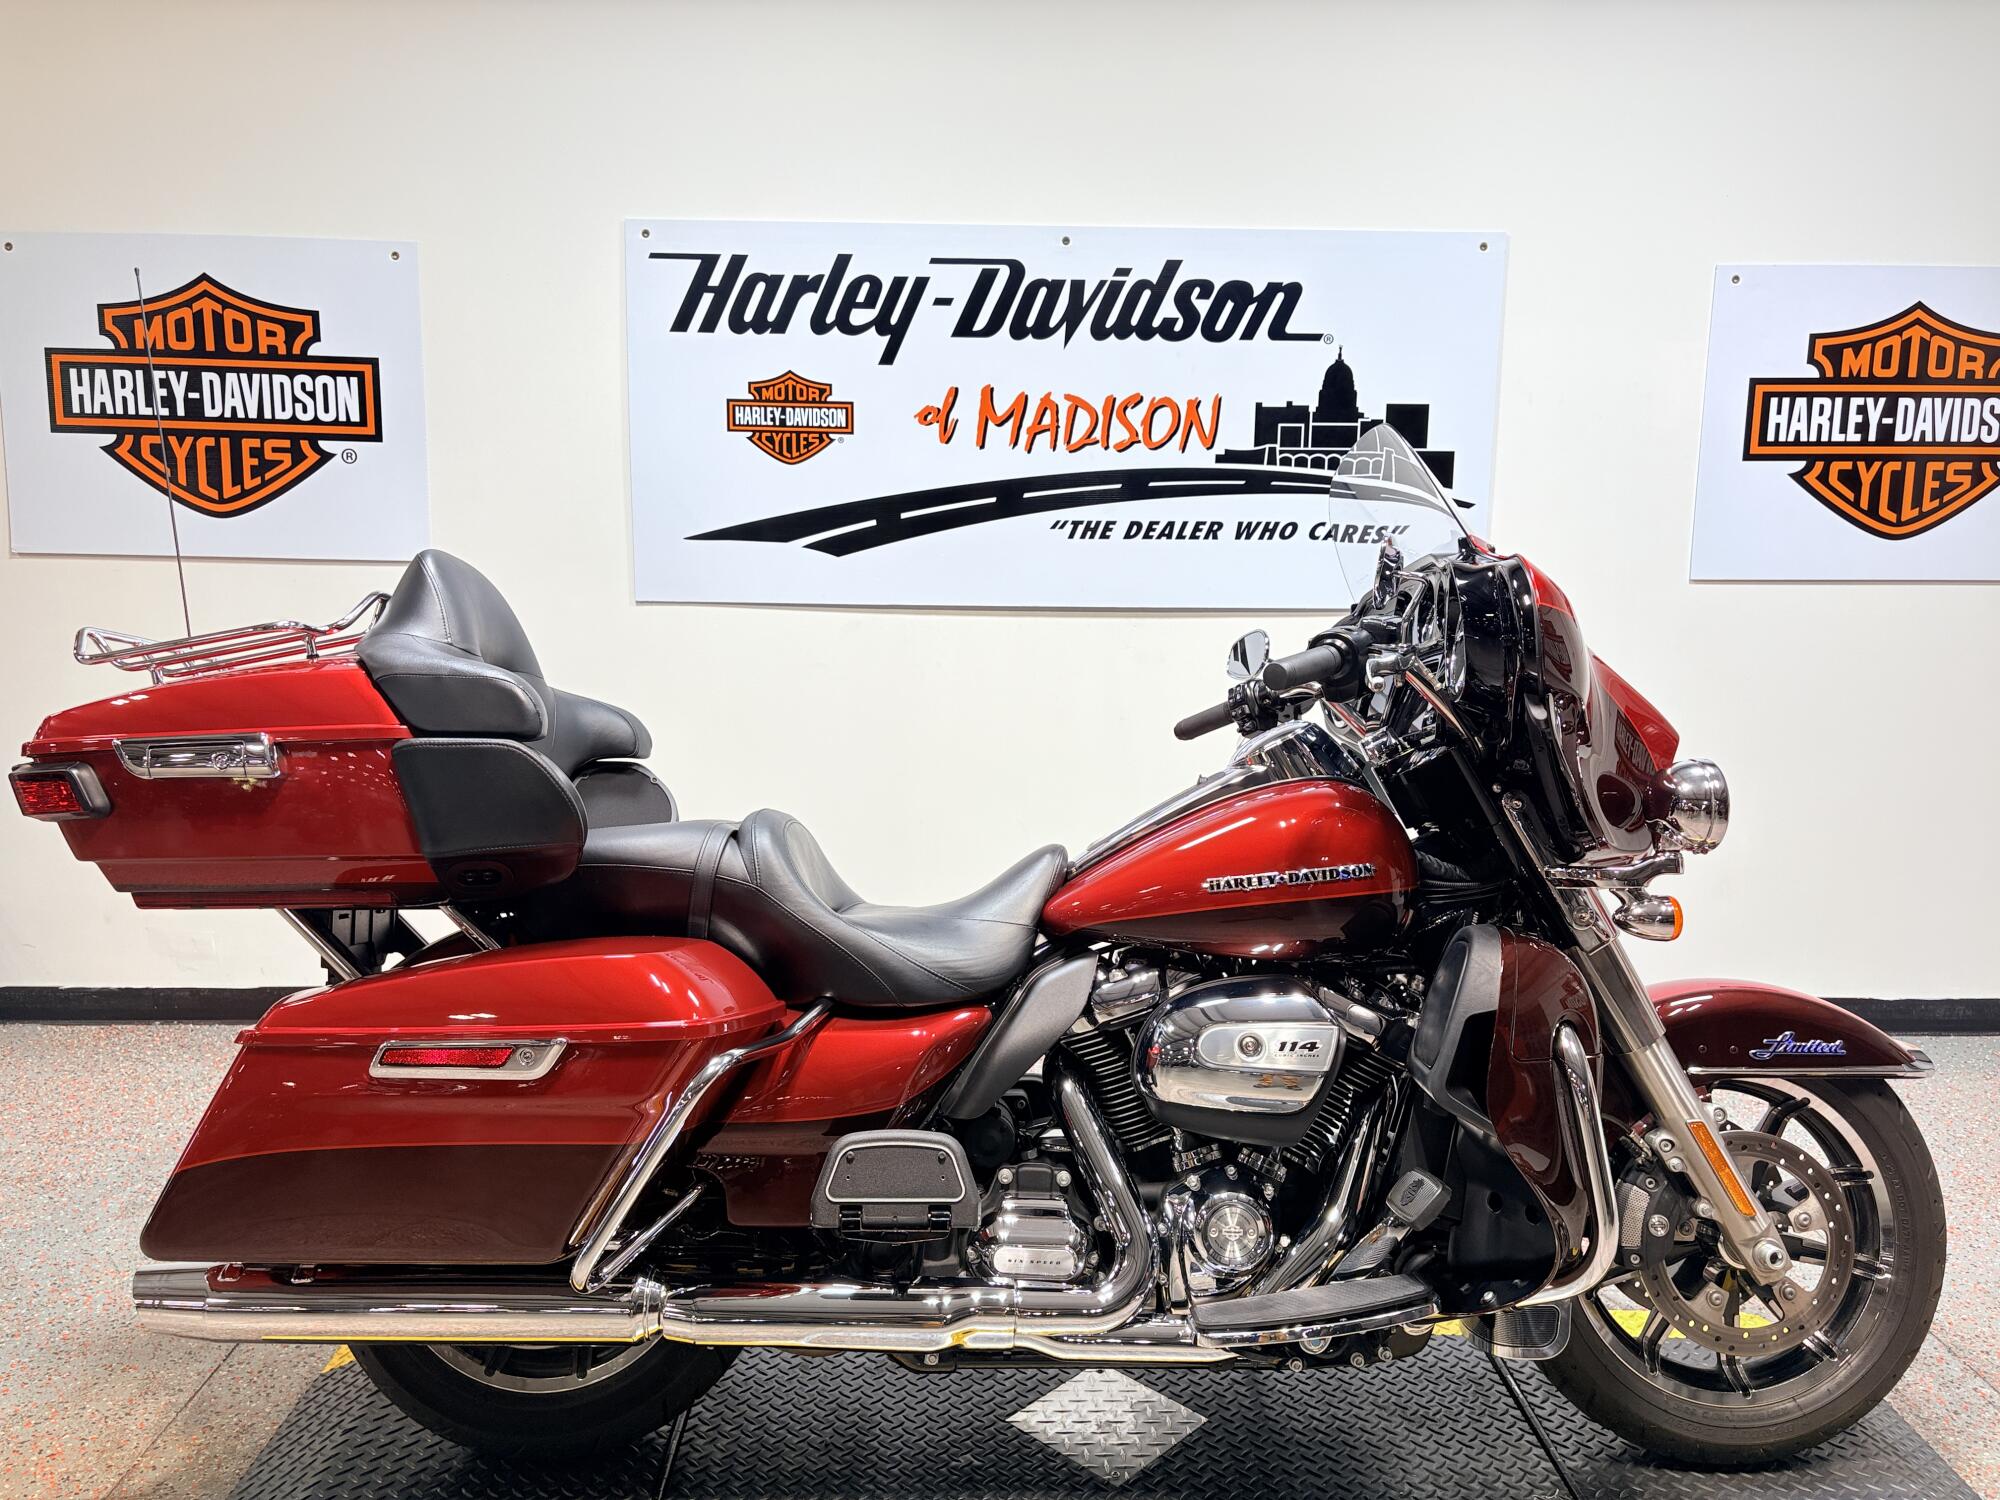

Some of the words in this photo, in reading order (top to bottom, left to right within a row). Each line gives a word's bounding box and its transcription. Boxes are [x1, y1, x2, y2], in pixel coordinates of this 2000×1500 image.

[134, 297, 286, 355] MOTOR
[648, 252, 1324, 365] Harley-Davidson
[1841, 324, 1985, 379] MOTOR
[69, 367, 361, 423] HARLEY-DAVIDSON
[734, 405, 847, 428] HARLEY-DAVIDSON
[761, 379, 820, 402] MOTOR
[761, 431, 820, 458] CYCLES
[975, 384, 1223, 454] MADISON
[140, 434, 293, 501] CYCLES
[1828, 460, 1974, 524] CYCLES
[1123, 520, 1223, 541] DEALER
[1235, 521, 1299, 541] WHO
[1278, 1042, 1320, 1053] 114
[1749, 1031, 1847, 1060] Limited
